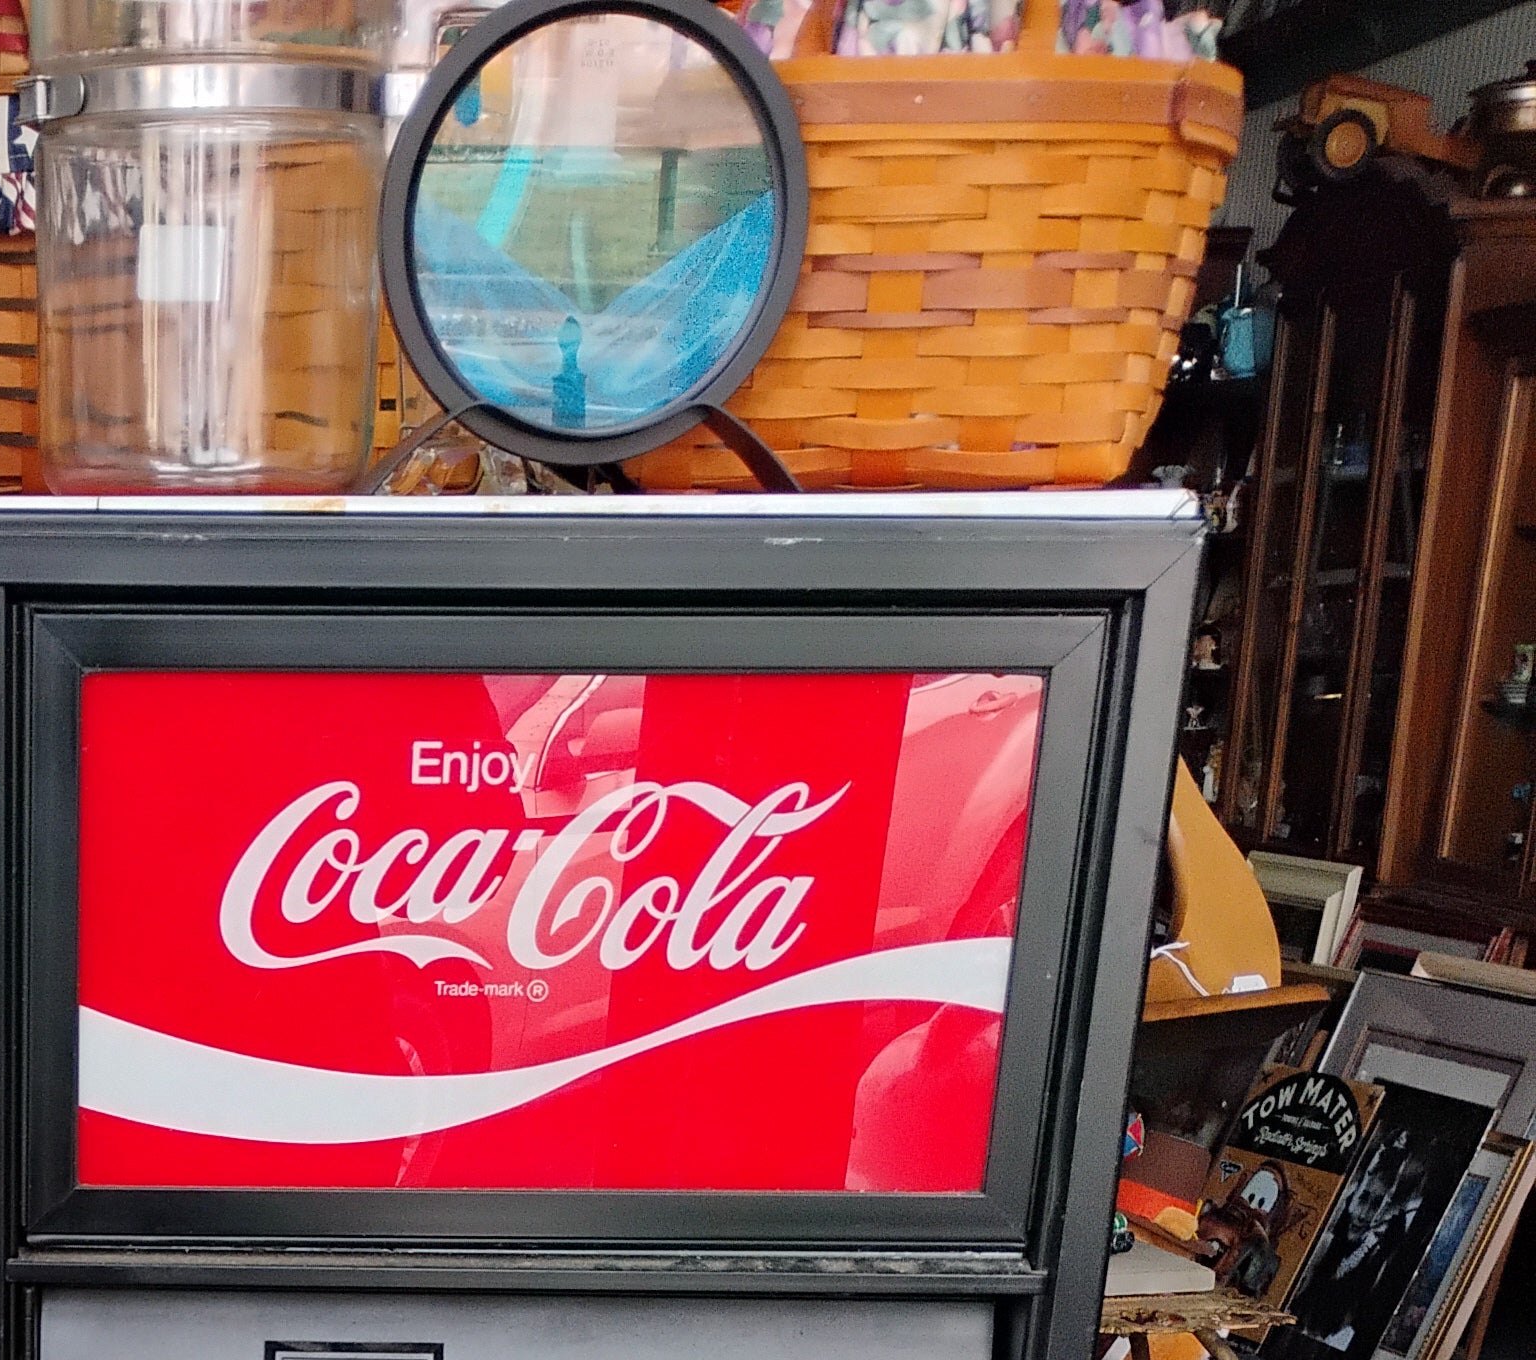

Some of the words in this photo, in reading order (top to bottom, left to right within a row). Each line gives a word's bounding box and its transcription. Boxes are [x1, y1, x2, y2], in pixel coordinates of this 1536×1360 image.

[411, 741, 536, 793] Enjoy
[218, 780, 852, 971] Coca-Cola
[434, 980, 524, 997] Trade-mark
[1242, 1082, 1298, 1130] TOW
[1298, 1077, 1357, 1153] MATER
